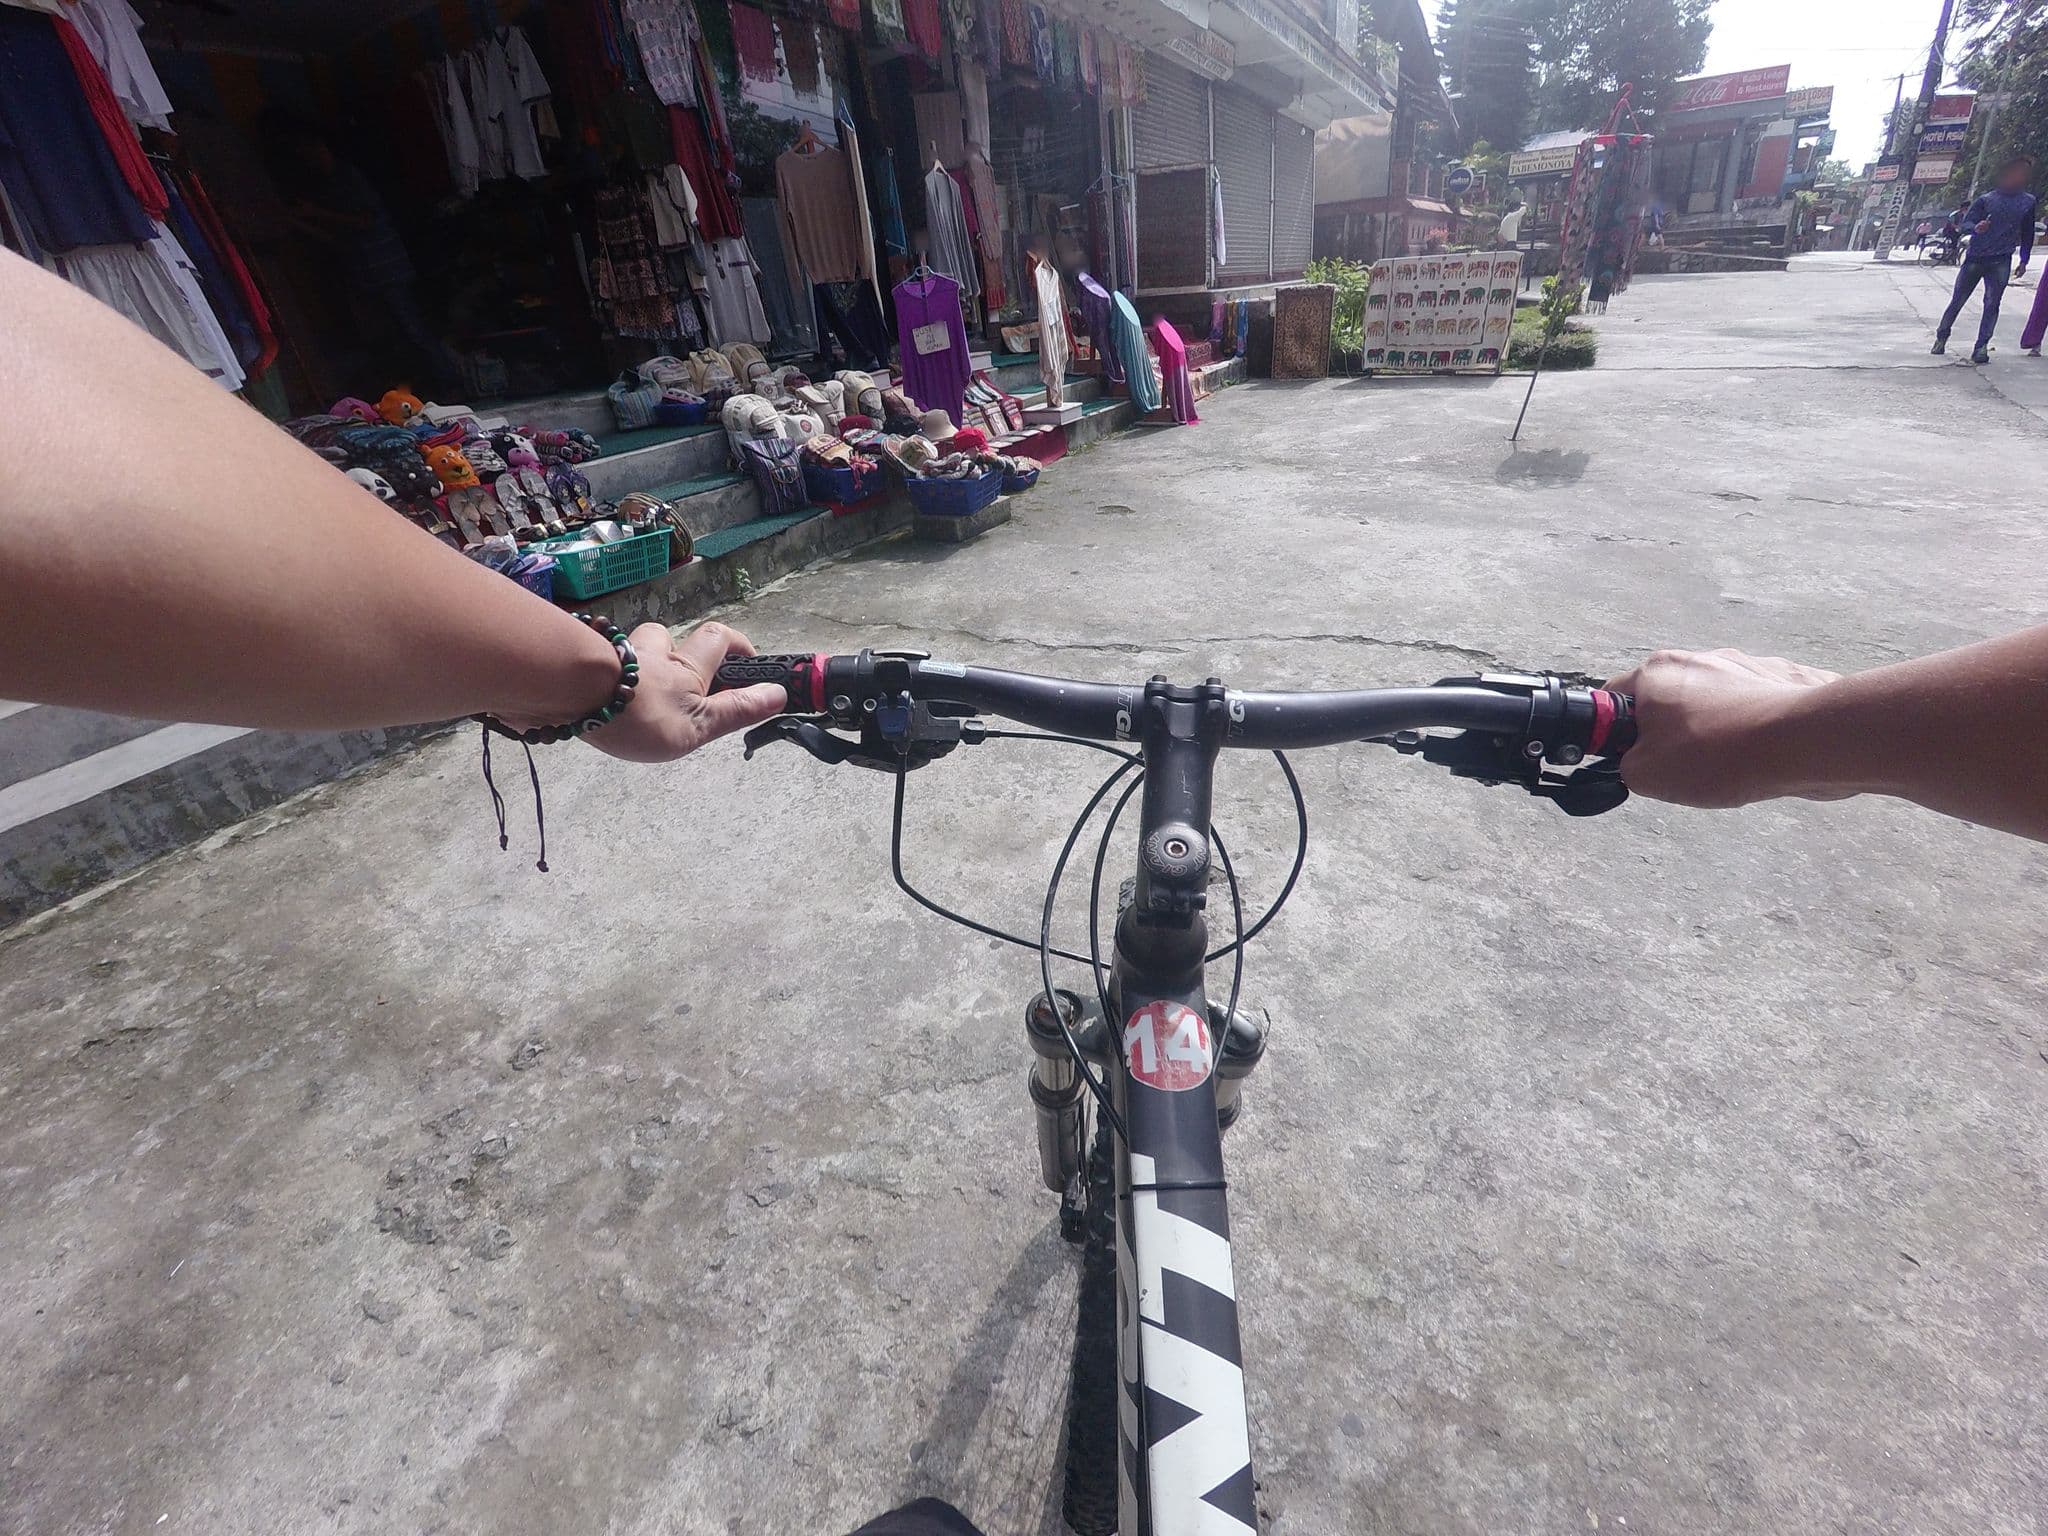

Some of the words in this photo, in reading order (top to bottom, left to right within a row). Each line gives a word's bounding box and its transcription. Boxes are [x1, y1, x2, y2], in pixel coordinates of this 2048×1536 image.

[1510, 159, 1572, 174] TABEMONOYA
[725, 666, 781, 678] SPORT
[1125, 1011, 1209, 1075] 14
